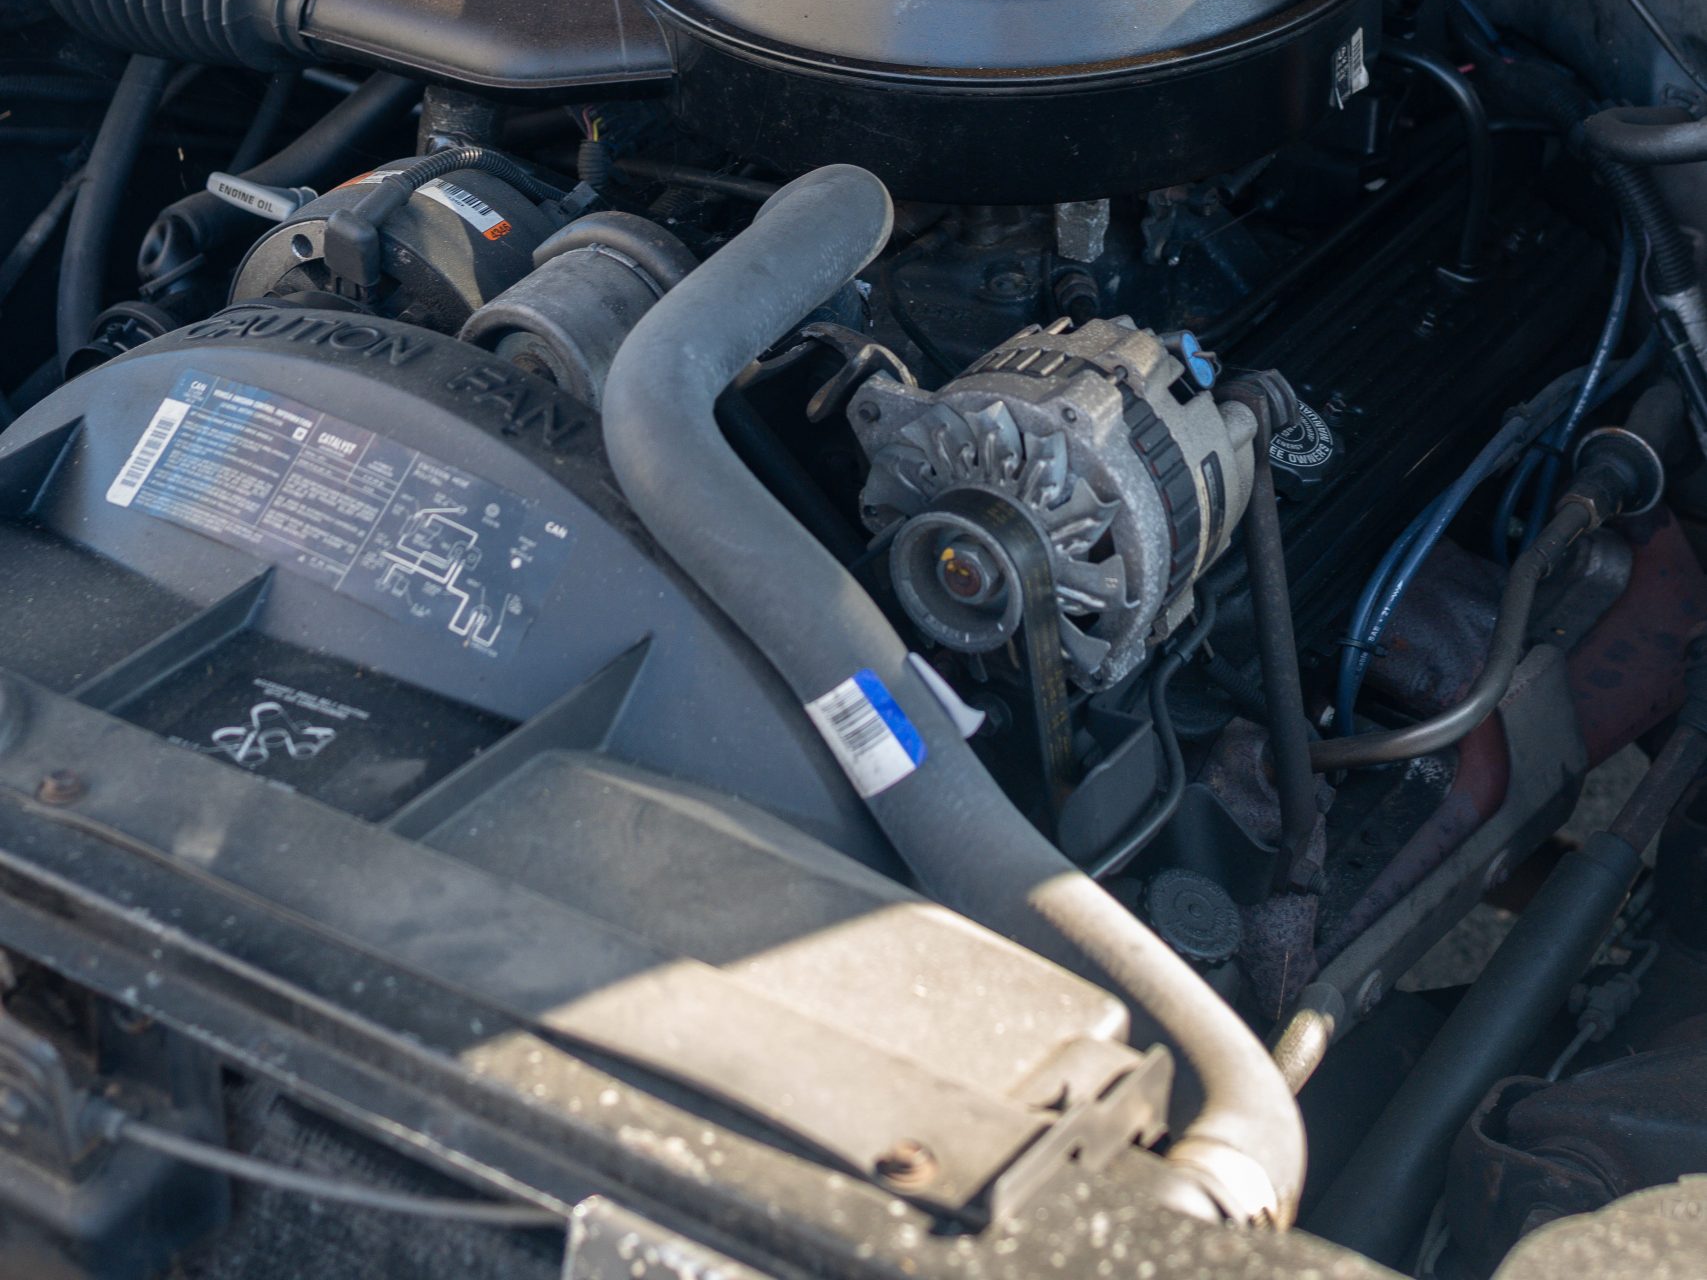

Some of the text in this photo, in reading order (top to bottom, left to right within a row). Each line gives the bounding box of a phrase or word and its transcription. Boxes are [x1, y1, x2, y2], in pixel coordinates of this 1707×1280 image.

[218, 182, 273, 213] ENGINE OIL
[185, 315, 586, 447] CAUTION FAN
[317, 431, 357, 454] CATALYST
[1269, 445, 1285, 459] EE
[544, 520, 569, 540] CAN
